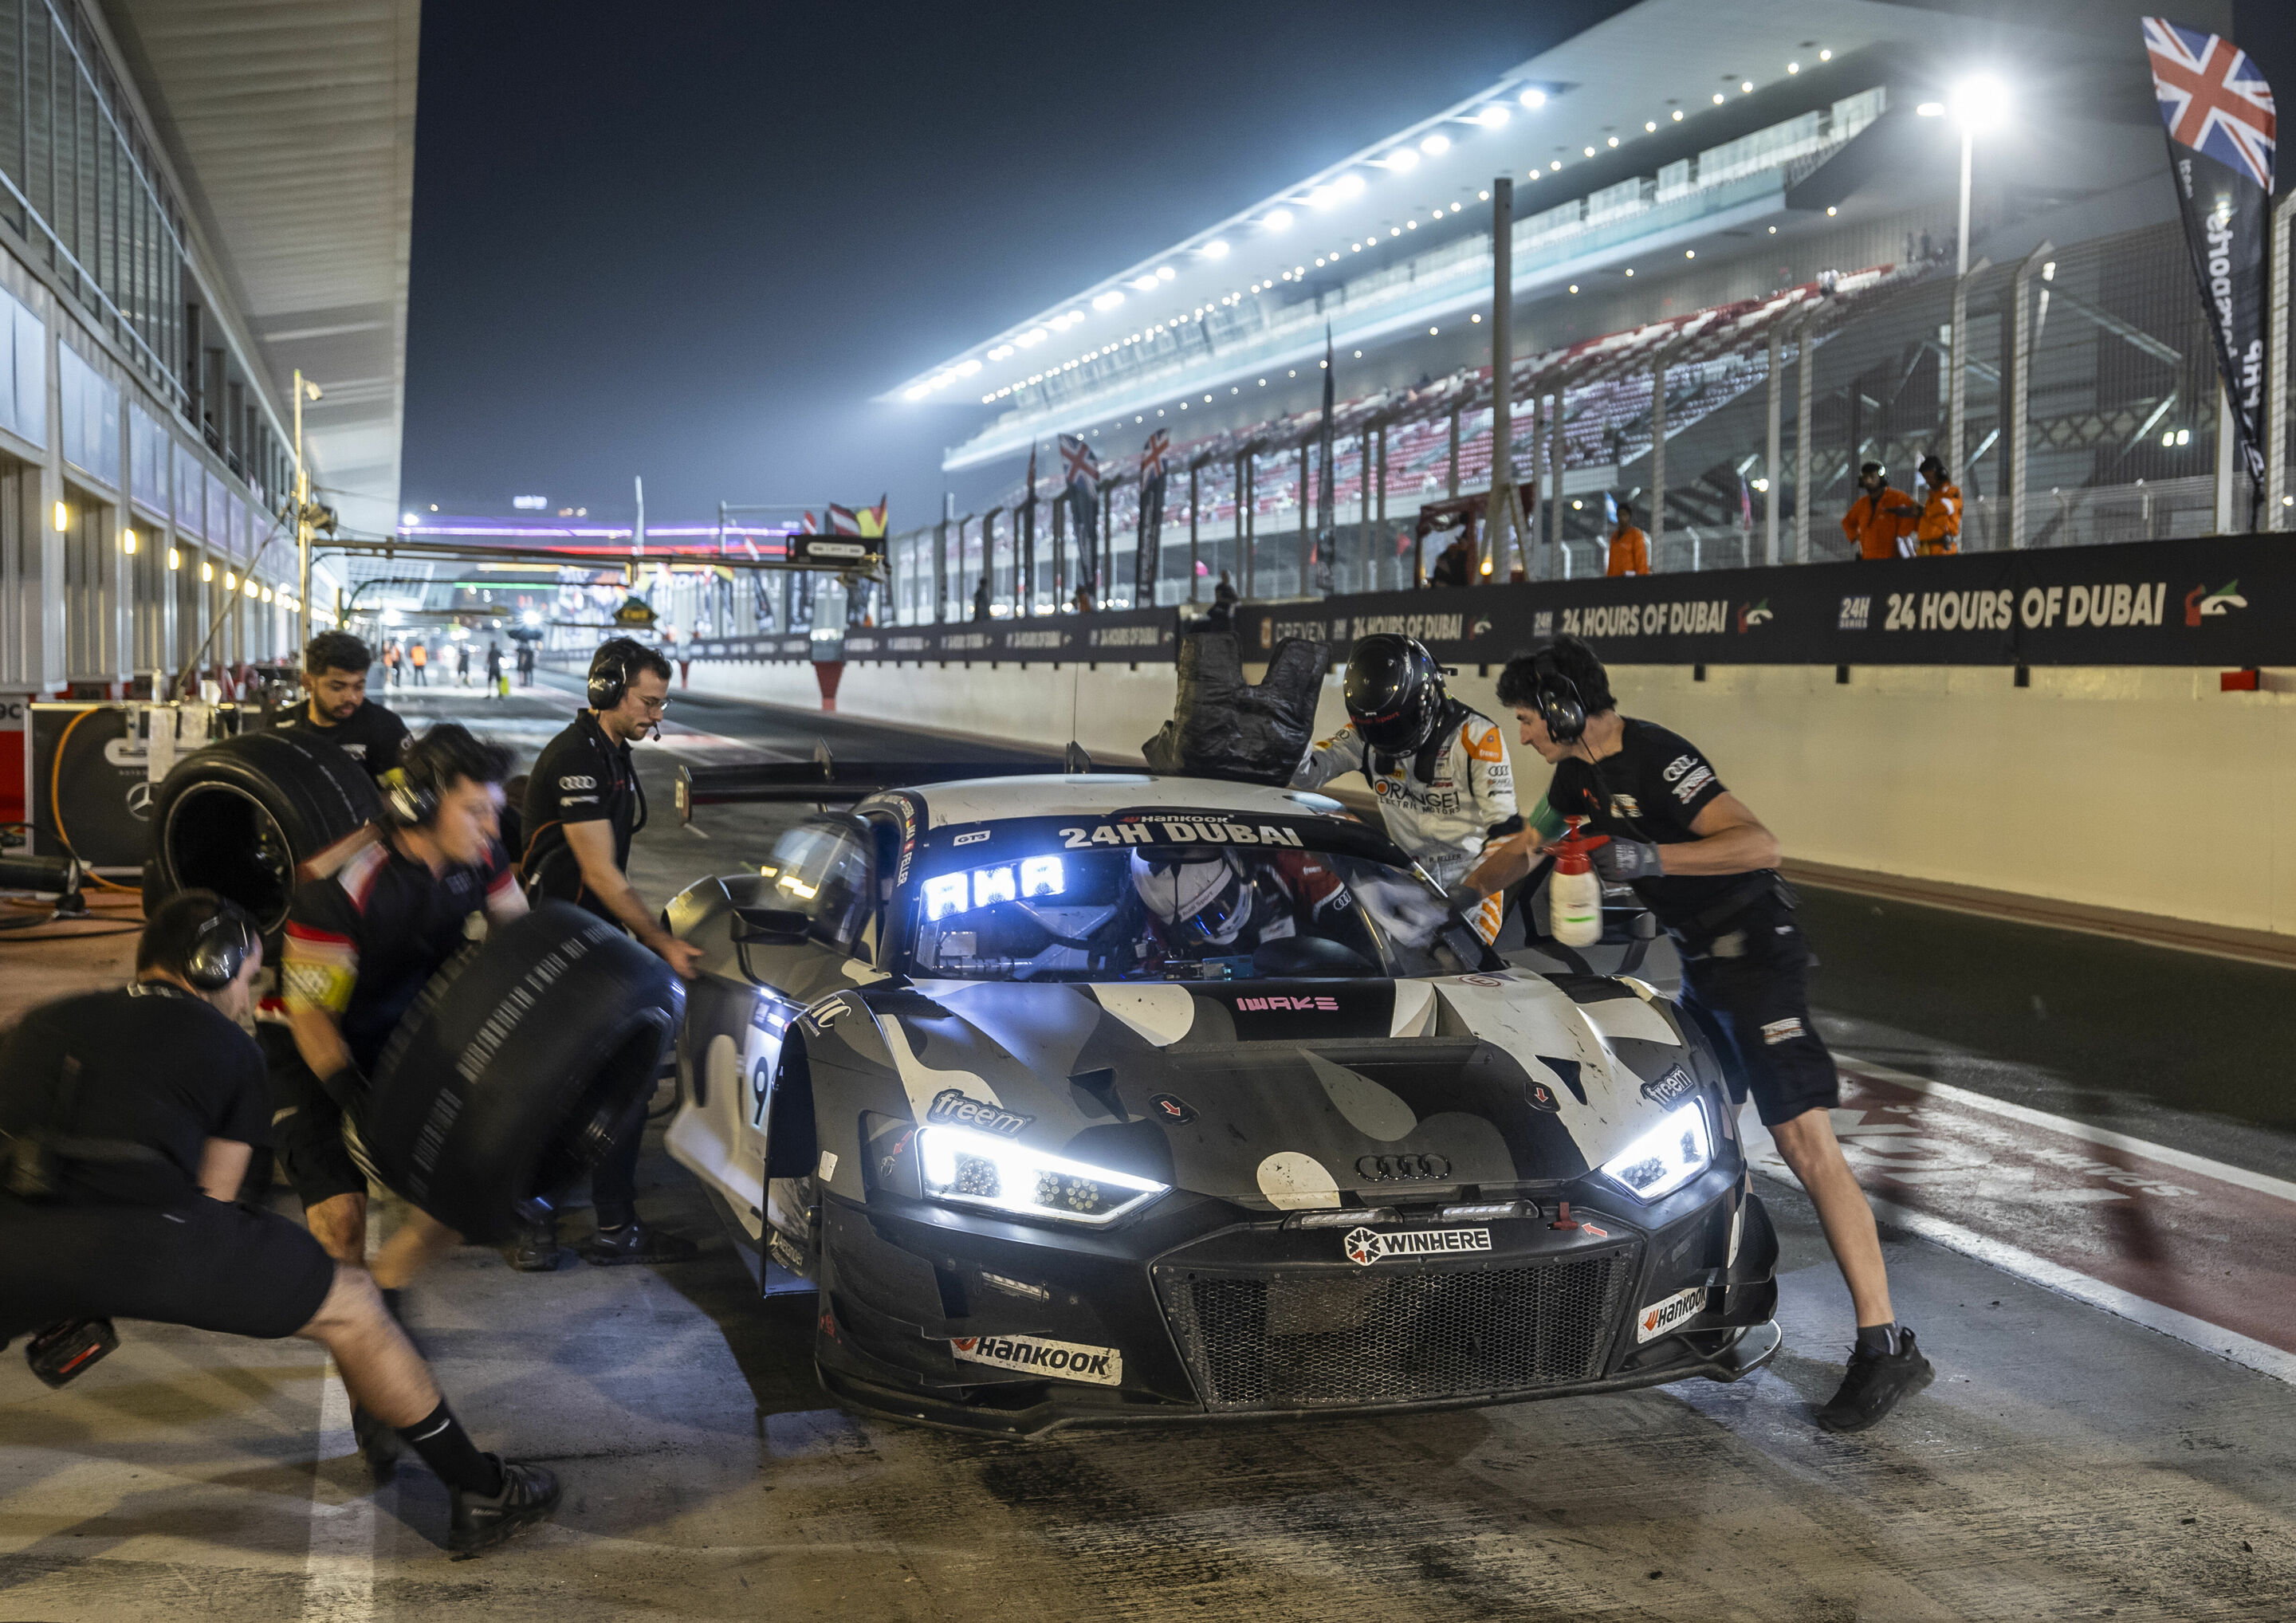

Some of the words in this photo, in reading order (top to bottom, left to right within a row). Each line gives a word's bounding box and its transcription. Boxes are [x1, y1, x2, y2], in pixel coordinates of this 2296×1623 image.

[1562, 607, 1580, 636] 24
[1582, 604, 1640, 636] HOURS
[1642, 603, 1668, 634] OF
[1670, 600, 1728, 634] DUBAI
[1841, 596, 1870, 619] 24H
[1885, 593, 1916, 631] 24
[1920, 589, 2013, 631] HOURS
[2021, 587, 2063, 629] OF
[2066, 583, 2167, 627] DUBAI
[1406, 615, 1423, 640] OF
[1425, 613, 1463, 640] DUBAI
[1375, 779, 1460, 808] ORANGE1
[957, 832, 987, 843] GT3
[1059, 823, 1154, 848] 24H
[1162, 823, 1304, 847] DUBAI
[897, 851, 913, 887] FELLER
[1645, 1069, 1691, 1105] freem
[934, 1092, 1024, 1133] freem
[1382, 1231, 1489, 1253] WINHERE
